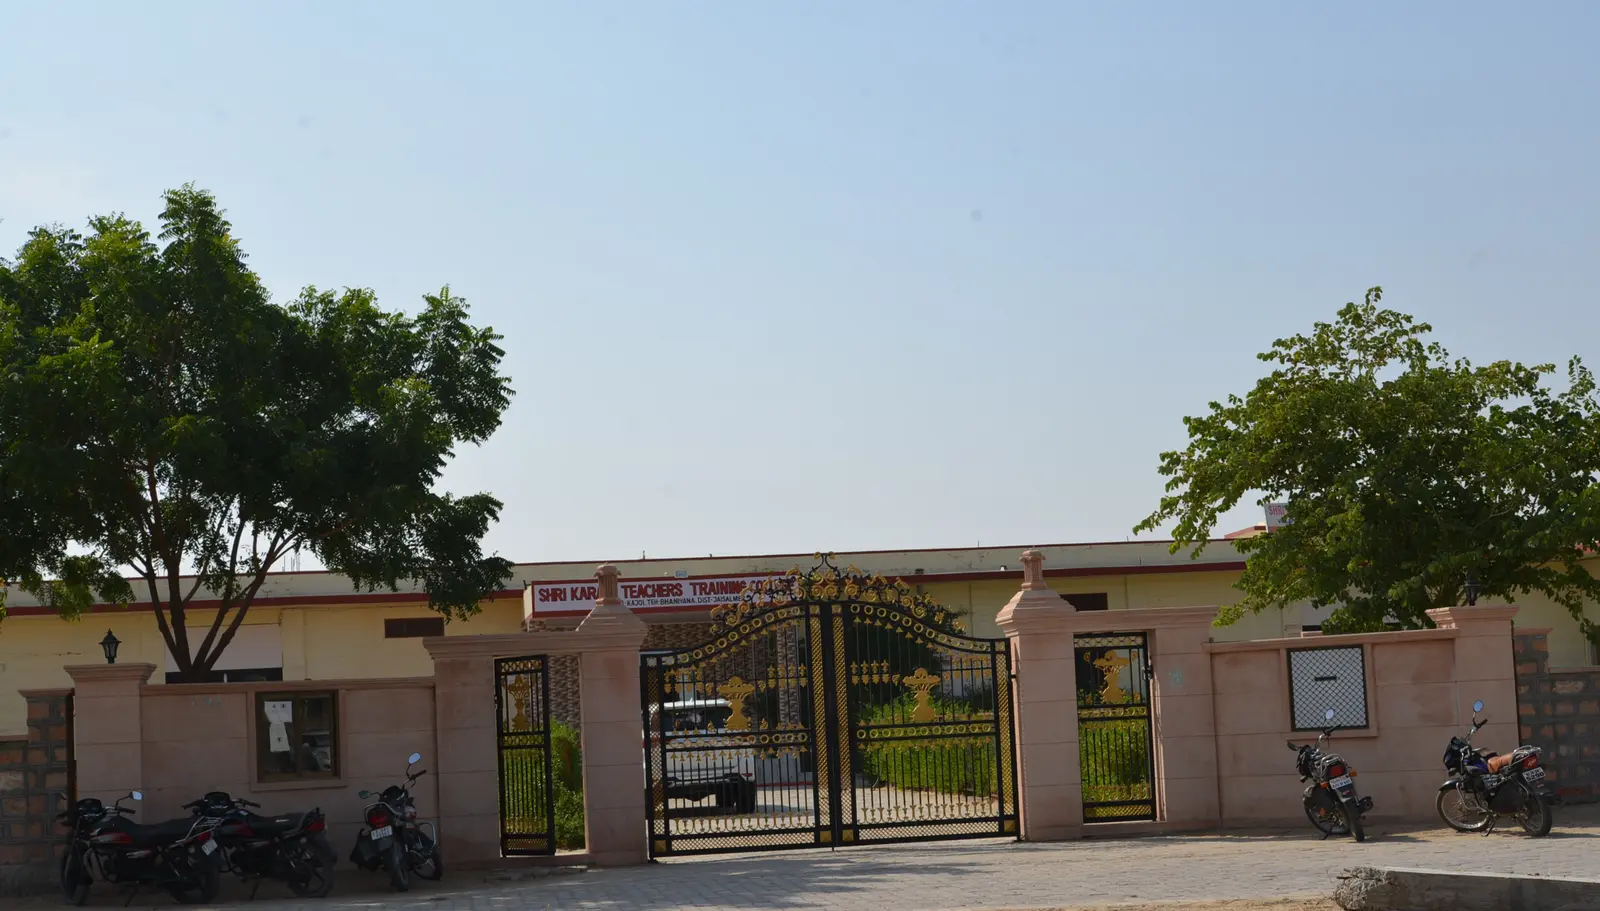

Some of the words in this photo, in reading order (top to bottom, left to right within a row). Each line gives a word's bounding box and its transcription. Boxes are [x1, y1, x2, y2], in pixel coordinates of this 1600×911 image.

[538, 587, 567, 602] SHRI
[571, 586, 599, 601] KAR
[620, 583, 683, 599] TEACHERS
[689, 580, 746, 596] TRAINING
